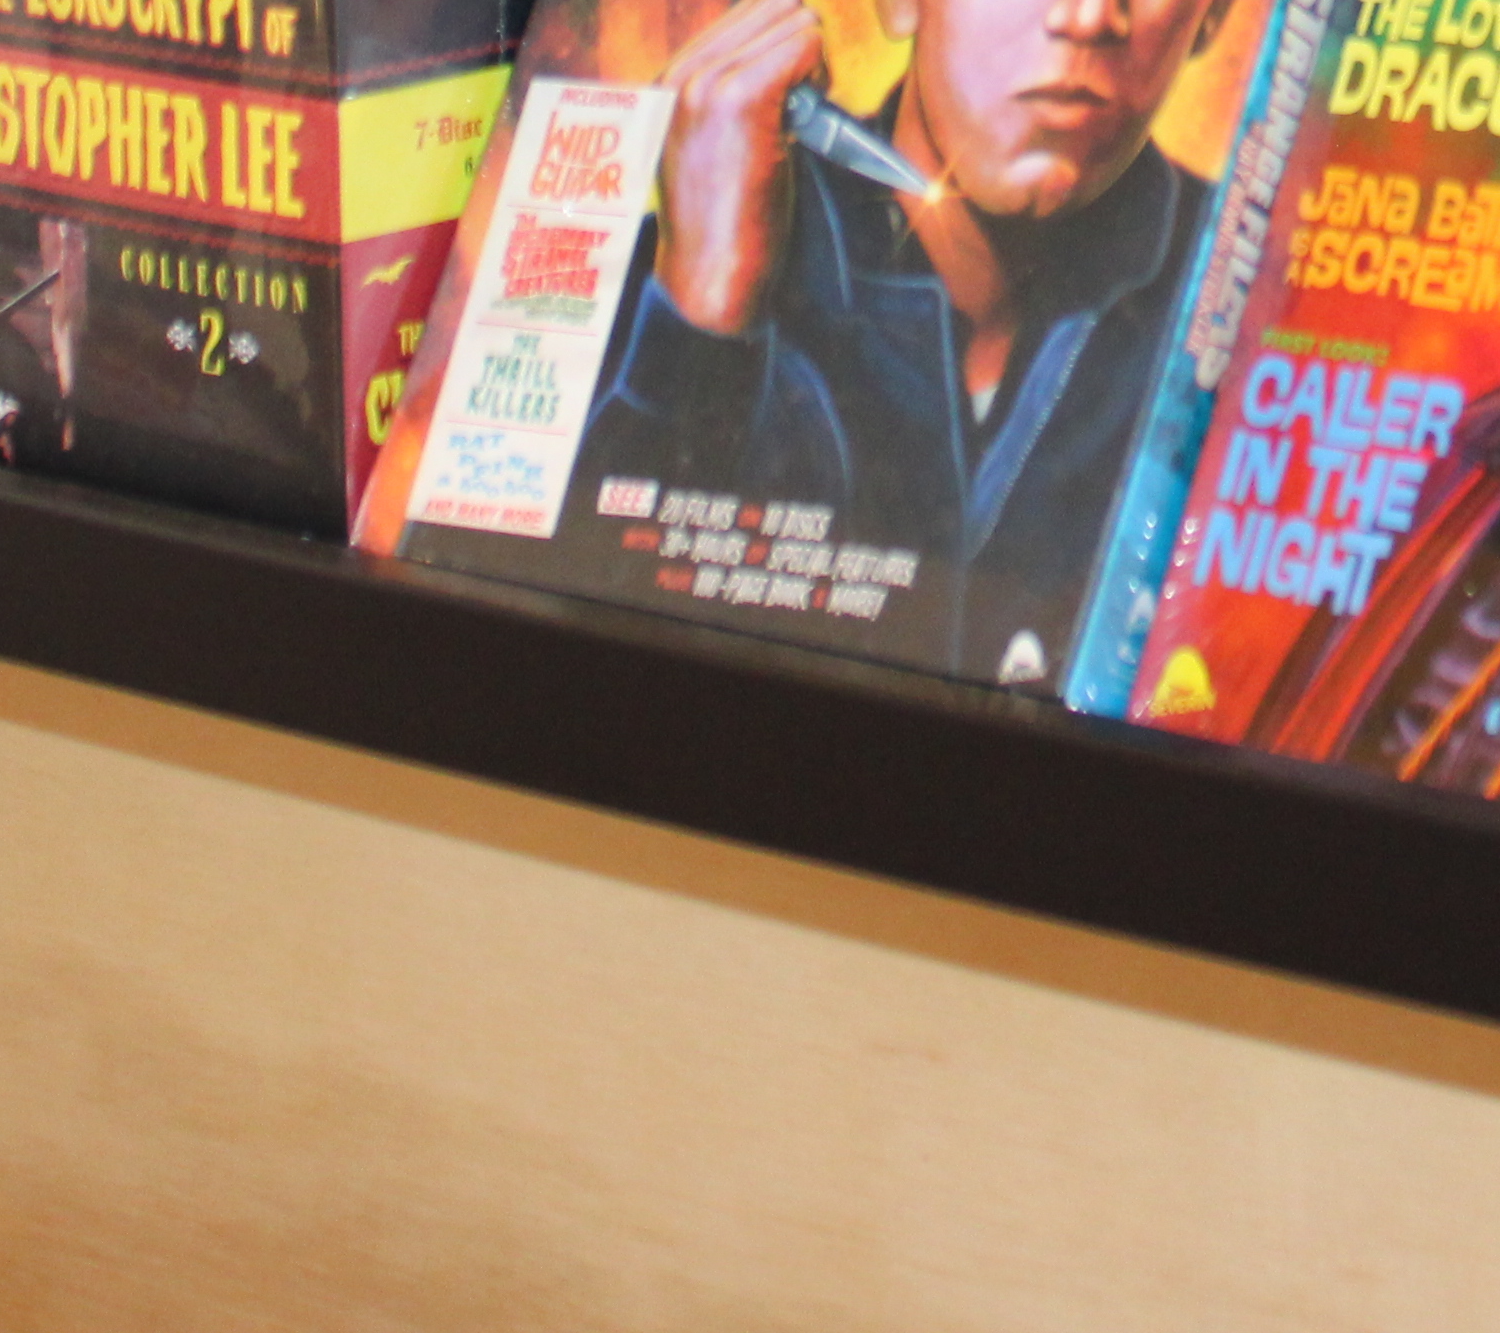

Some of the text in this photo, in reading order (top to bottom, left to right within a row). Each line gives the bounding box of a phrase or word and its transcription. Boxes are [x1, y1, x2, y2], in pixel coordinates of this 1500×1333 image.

[264, 6, 298, 57] OF
[220, 100, 306, 220] LEE
[542, 110, 622, 163] WILD
[529, 161, 625, 203] GUITAR
[120, 246, 309, 315] COLLECTION
[1195, 203, 1273, 392] FILMS
[199, 307, 225, 378] 2
[1261, 327, 1314, 350] FIRST
[483, 354, 557, 390] THRILL
[466, 386, 561, 425] KILLERS
[1240, 354, 1466, 459] CALLER
[1216, 427, 1431, 533] IN THE
[687, 492, 739, 532] FILMS
[1191, 507, 1392, 617] NIGHT
